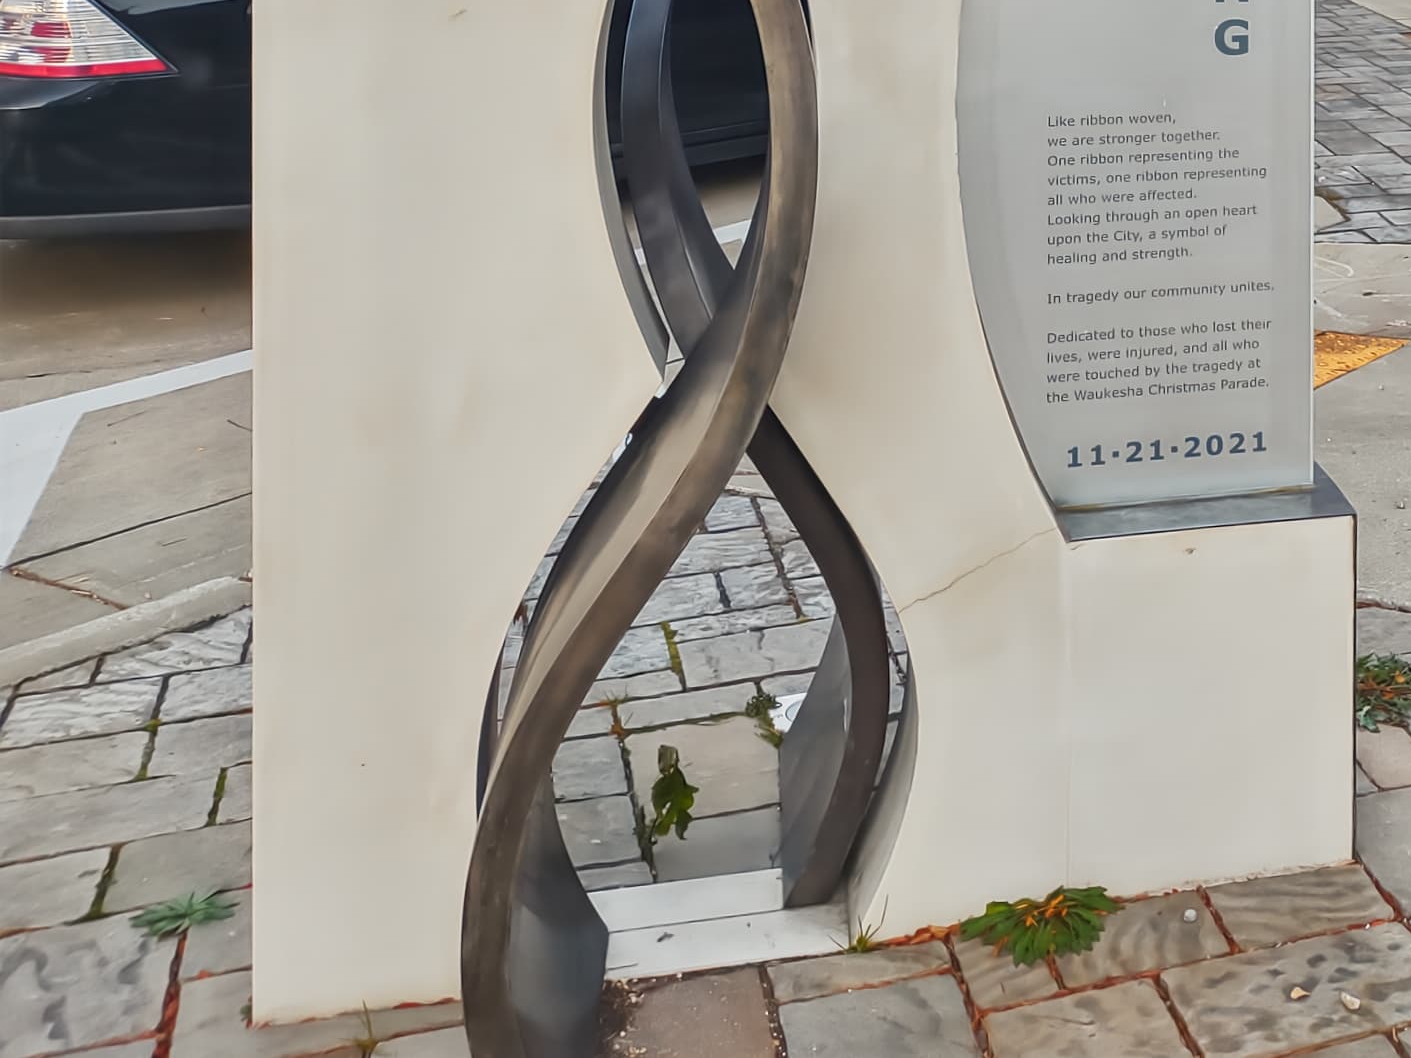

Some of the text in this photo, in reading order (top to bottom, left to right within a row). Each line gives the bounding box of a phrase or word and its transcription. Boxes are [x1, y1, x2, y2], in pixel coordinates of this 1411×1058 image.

[1047, 113, 1177, 128] Like ribbon woven,
[1046, 129, 1221, 148] we are stronger together.
[1046, 146, 1240, 167] One ribbon representing the
[1046, 166, 1268, 187] victims, one ribbon representing
[1046, 186, 1198, 207] all who were affected.
[1047, 204, 1258, 227] Looking through an open heart
[1046, 223, 1228, 248] upon the City, a symbol of
[1046, 245, 1194, 266] healing and strength.
[1046, 280, 1275, 306] In tragedy our community unites.
[1046, 318, 1273, 345] Dedicated to those who lost their
[1046, 338, 1261, 365] lives, were injured, and all who
[1046, 357, 1262, 384] were touched by the tragedy at
[1045, 375, 1270, 405] the Waukesha Christmas Parade.
